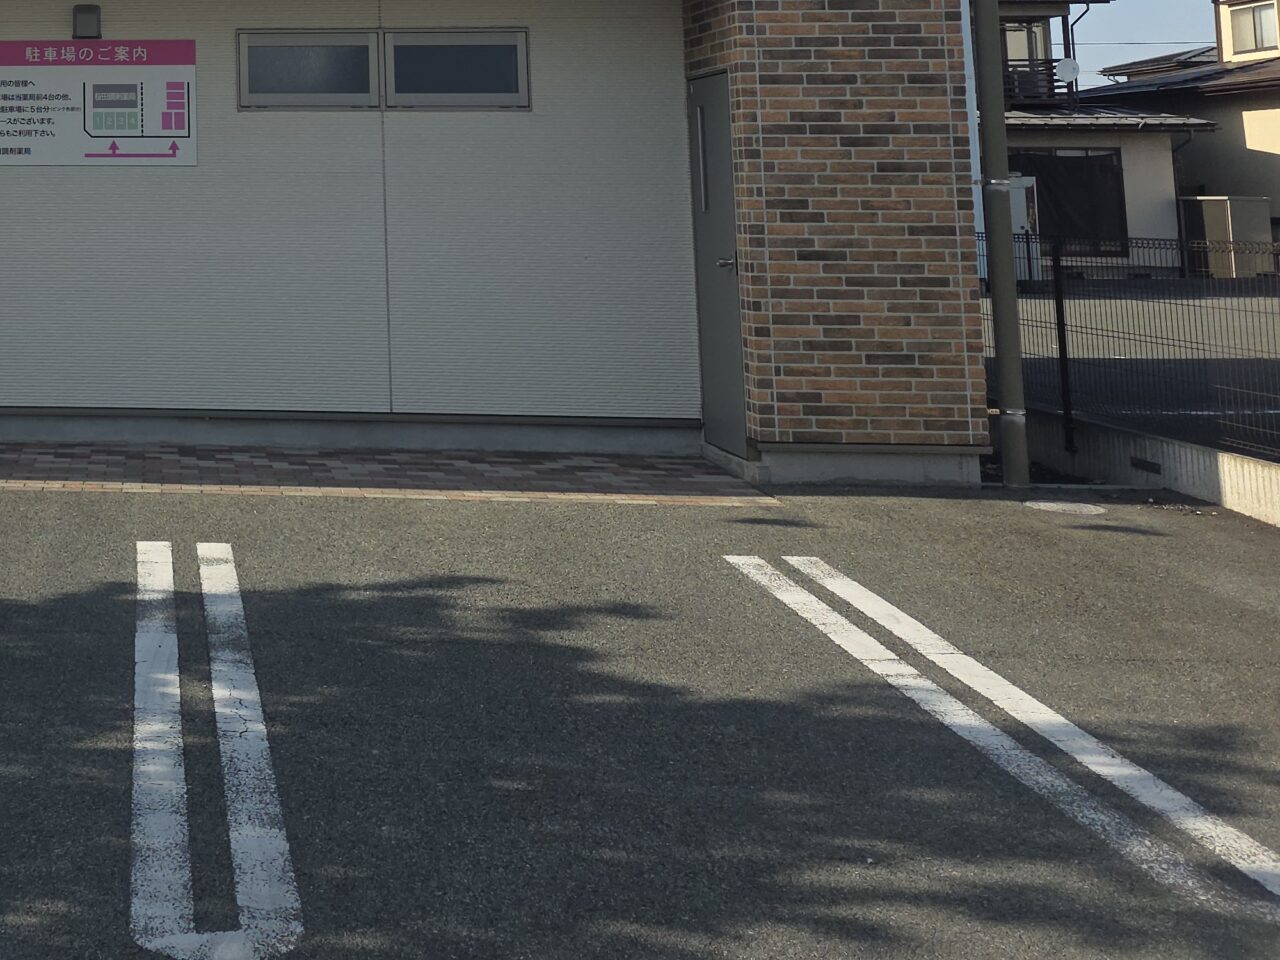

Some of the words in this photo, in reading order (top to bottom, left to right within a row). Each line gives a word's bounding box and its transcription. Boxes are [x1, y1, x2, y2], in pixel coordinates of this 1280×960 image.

[25, 46, 148, 62] 駐車場のご案内
